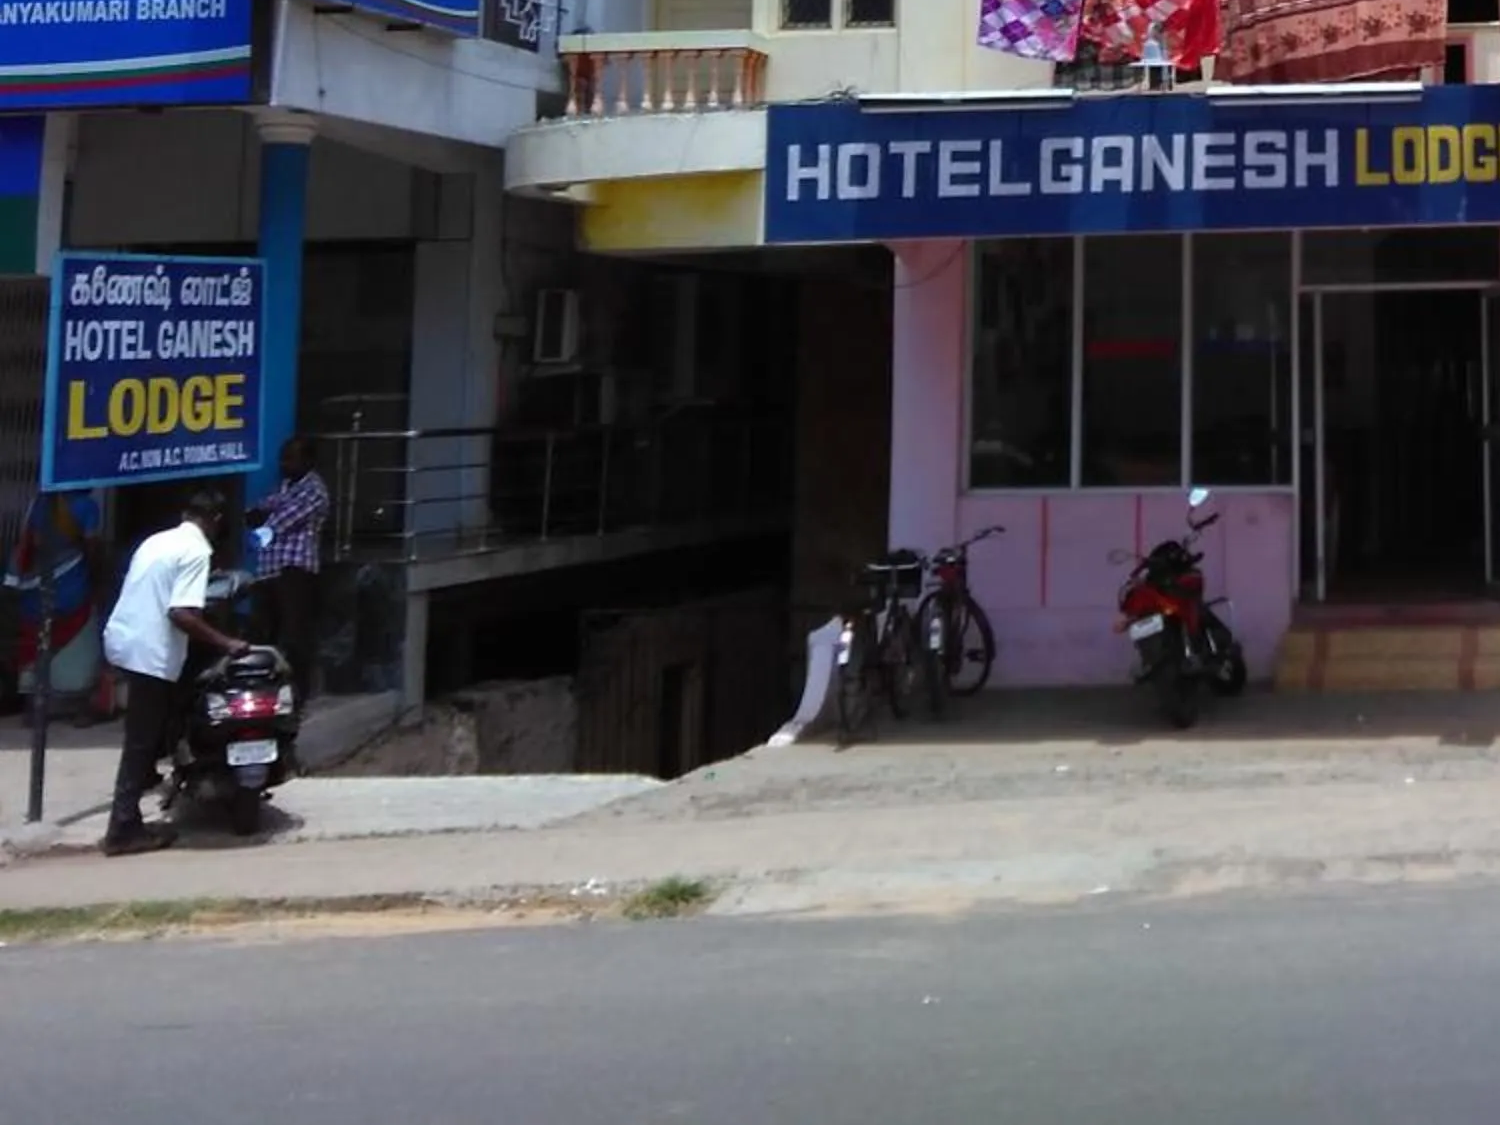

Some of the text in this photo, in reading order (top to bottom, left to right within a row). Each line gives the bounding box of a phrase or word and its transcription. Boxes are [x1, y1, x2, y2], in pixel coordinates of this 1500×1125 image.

[787, 138, 1031, 202] HOTEL
[1040, 127, 1340, 194] GANESH
[71, 265, 252, 311] கணேஷ் லாட்ஜ்
[64, 319, 255, 362] HOTEL GANESH
[67, 373, 245, 441] LODGE
